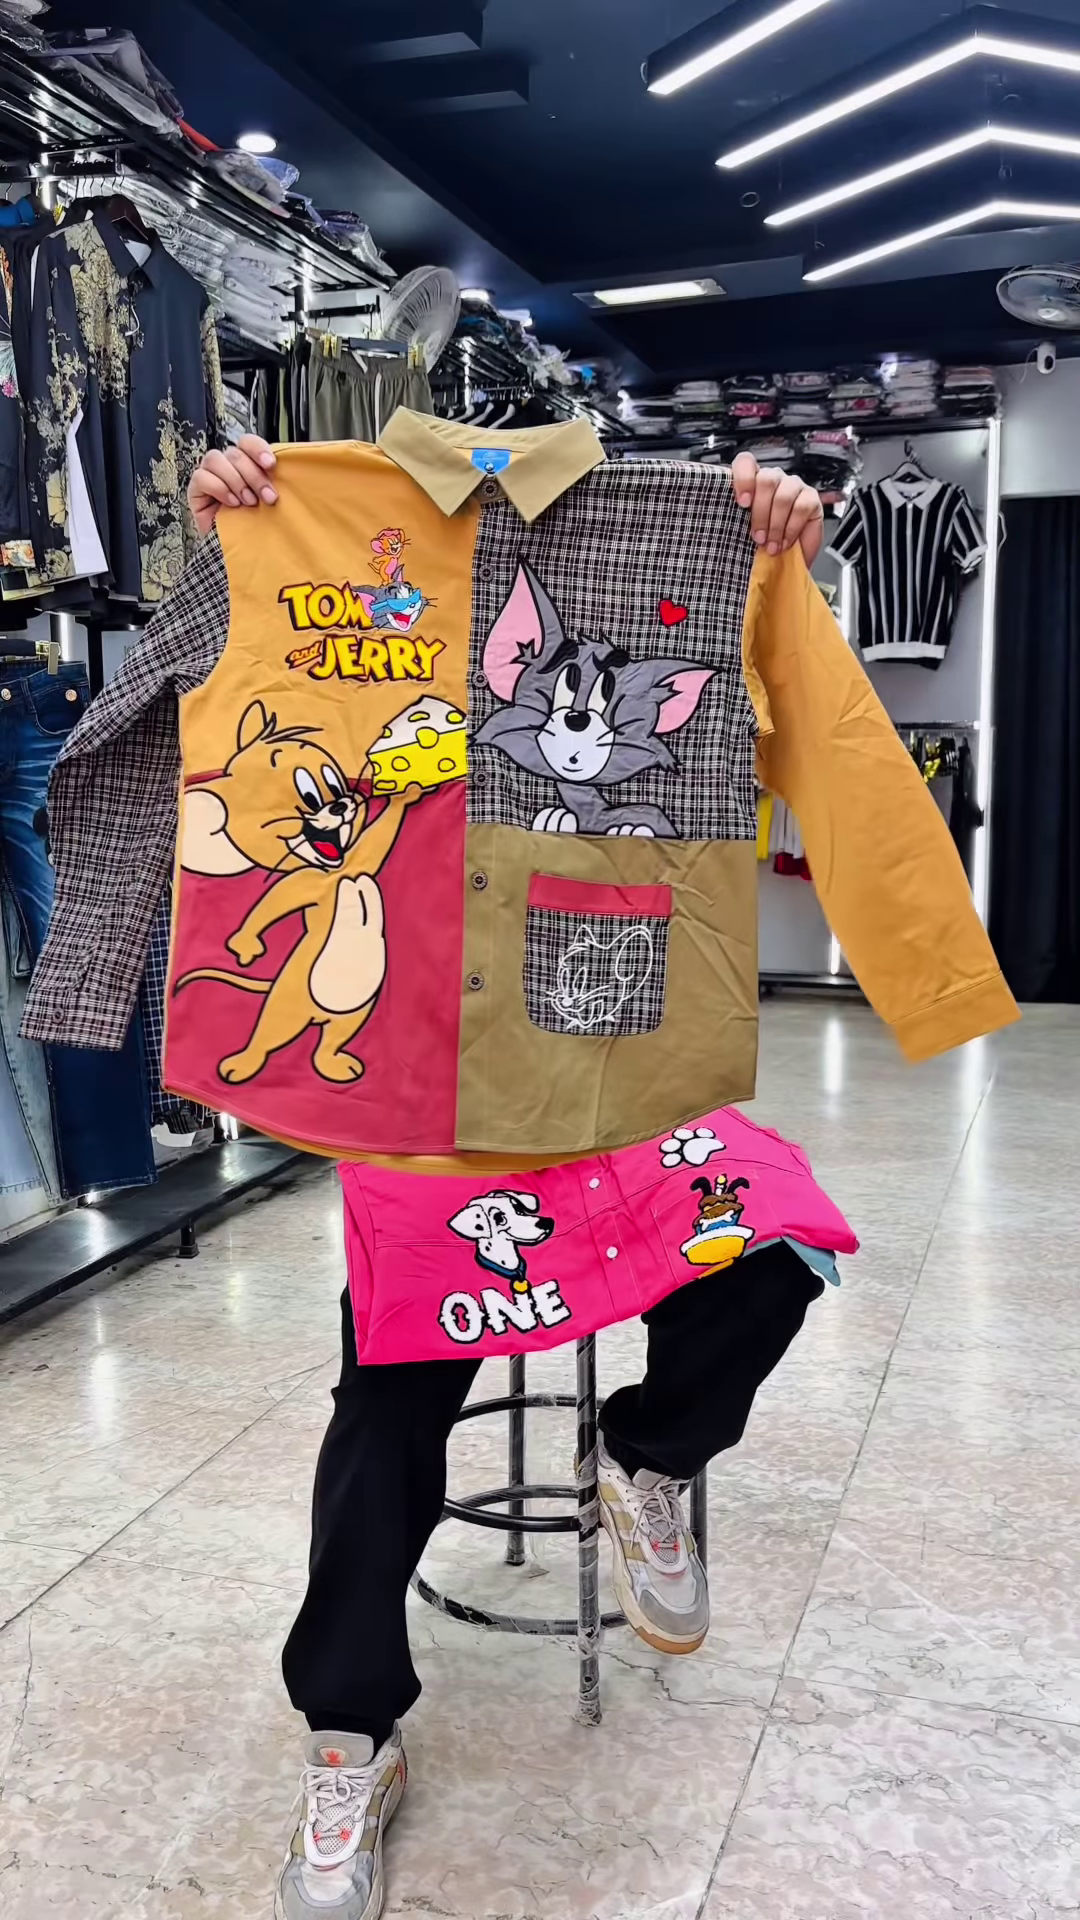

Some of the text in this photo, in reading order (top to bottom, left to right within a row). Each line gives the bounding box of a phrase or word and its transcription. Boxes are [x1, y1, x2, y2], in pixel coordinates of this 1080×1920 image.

[278, 582, 375, 630] TOM
[286, 634, 447, 682] and JERRY
[437, 1278, 572, 1344] ONE
